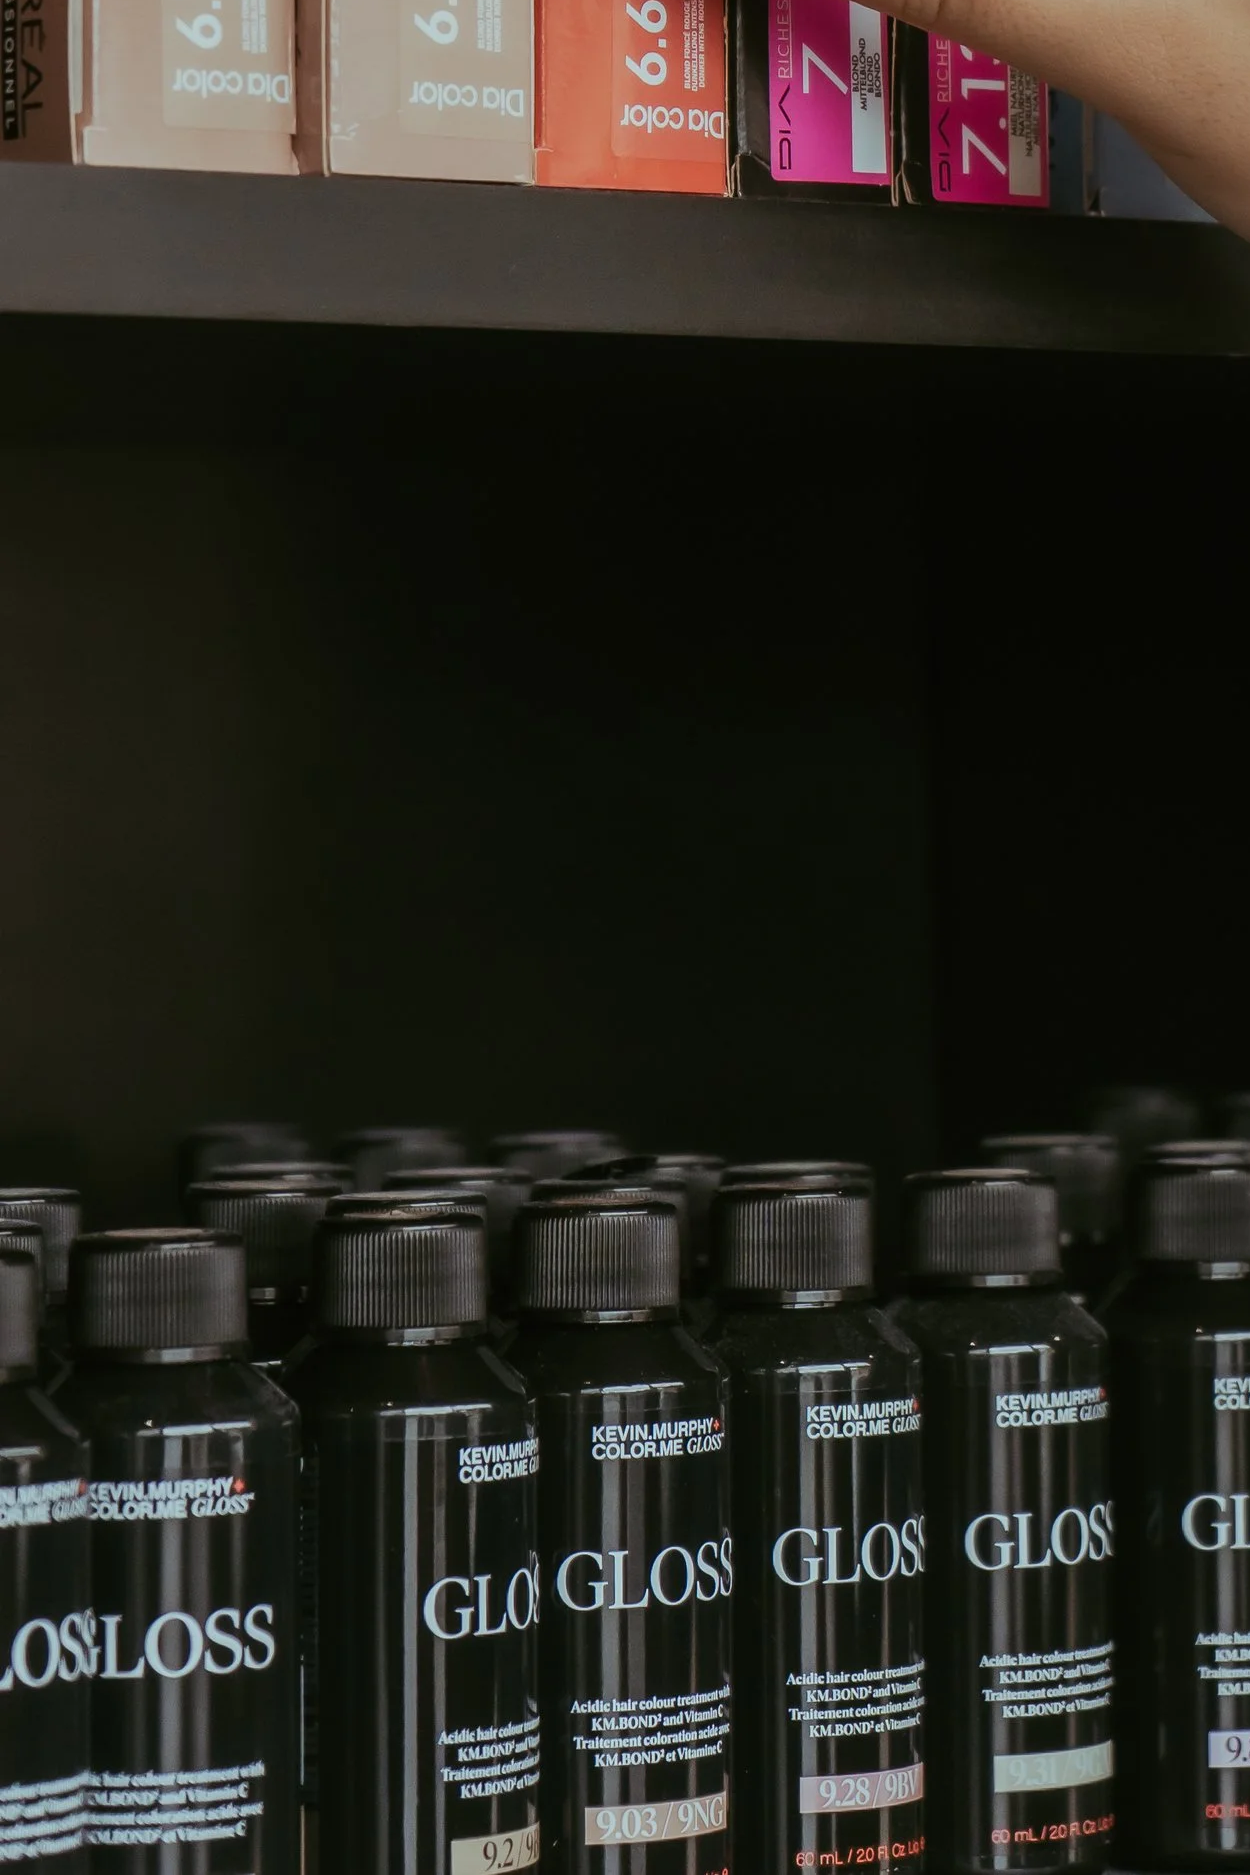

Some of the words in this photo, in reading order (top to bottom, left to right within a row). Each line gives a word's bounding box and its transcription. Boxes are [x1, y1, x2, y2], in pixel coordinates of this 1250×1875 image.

[802, 42, 848, 95] 7
[859, 38, 867, 110] MITTELBLOND
[873, 53, 881, 97] BIONDO
[173, 68, 243, 99] color
[247, 73, 291, 105] Dia
[409, 81, 478, 111] color
[482, 87, 524, 118] Dia
[620, 104, 684, 133] color
[688, 108, 725, 139] Dia
[806, 1398, 914, 1423] KEVIN.MURPHY
[996, 1387, 1101, 1411] KEVIN.MURPHY
[592, 1417, 714, 1443] KEVIN.MURPHY
[806, 1419, 891, 1440] COLOR.ME
[592, 1439, 684, 1460] COLOR.ME
[459, 1459, 528, 1484] COLOR.ME
[556, 1537, 733, 1611] GLOSS
[570, 1700, 611, 1714] Acidic
[612, 1698, 638, 1712] hair
[638, 1695, 676, 1710] colour
[677, 1690, 719, 1706] treatment
[663, 1713, 683, 1727] and
[684, 1708, 718, 1724] Vitamin
[717, 1704, 724, 1718] C
[438, 1727, 475, 1745] Acidic
[476, 1725, 498, 1741] hair
[573, 1735, 642, 1750] Traitement
[643, 1729, 697, 1747] coloration
[698, 1724, 718, 1740] acide
[666, 1749, 677, 1763] et
[677, 1745, 717, 1761] Vitamine
[716, 1740, 723, 1754] C
[819, 1777, 871, 1808] 9.28
[596, 1807, 657, 1840] 9.03
[678, 1796, 723, 1834] 9NG
[483, 1838, 514, 1872] 9.2
[820, 1850, 844, 1866] mL
